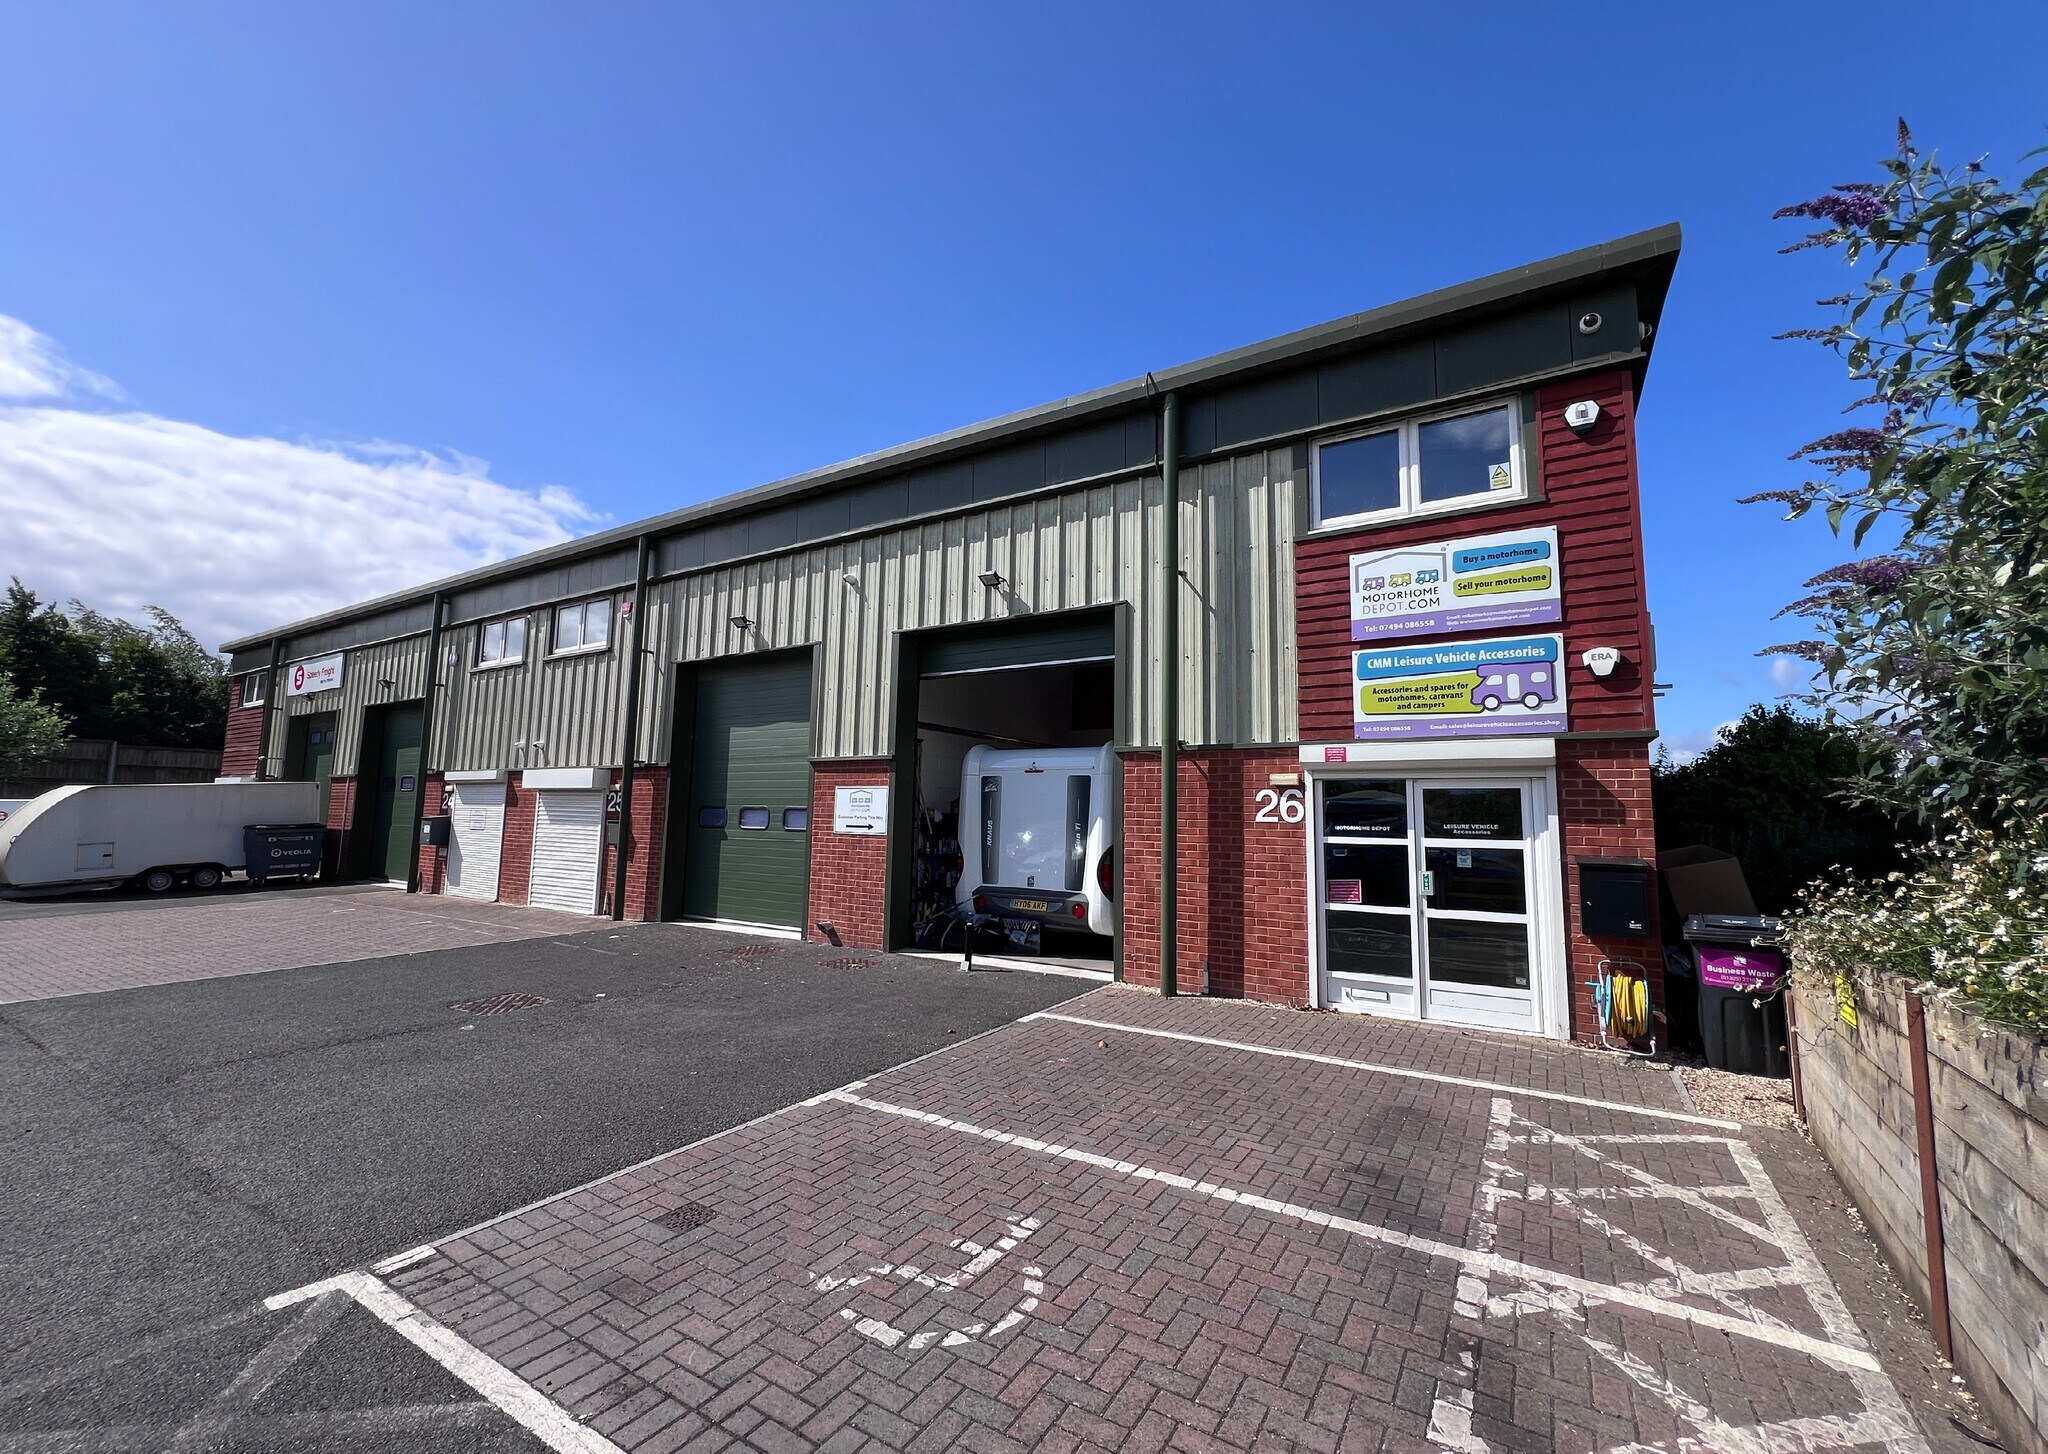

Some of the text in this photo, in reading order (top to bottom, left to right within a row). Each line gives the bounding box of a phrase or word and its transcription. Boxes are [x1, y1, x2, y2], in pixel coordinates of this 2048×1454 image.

[1463, 556, 1479, 564] Buy
[1487, 547, 1538, 560] motorhome
[1457, 574, 1547, 590] Sell your motorhome
[1362, 586, 1439, 603] MOTORHOME
[1362, 597, 1440, 615] DEPOT.COM
[1379, 622, 1404, 631] 07494
[1404, 619, 1435, 629] 086558
[1367, 645, 1546, 669] CMM Leisure Vehicle Accessories
[1591, 652, 1613, 661] ERA
[1372, 682, 1469, 695] Accessories and spares for
[1377, 692, 1464, 703] motorhomes, caravans
[1396, 702, 1446, 711] and campers
[441, 793, 454, 810] 24
[607, 791, 621, 812] 25
[1255, 789, 1305, 824] 26
[283, 848, 312, 856] VEOLIA
[1014, 900, 1046, 910] HY06 AKF
[1707, 965, 1775, 978] Business Waste
